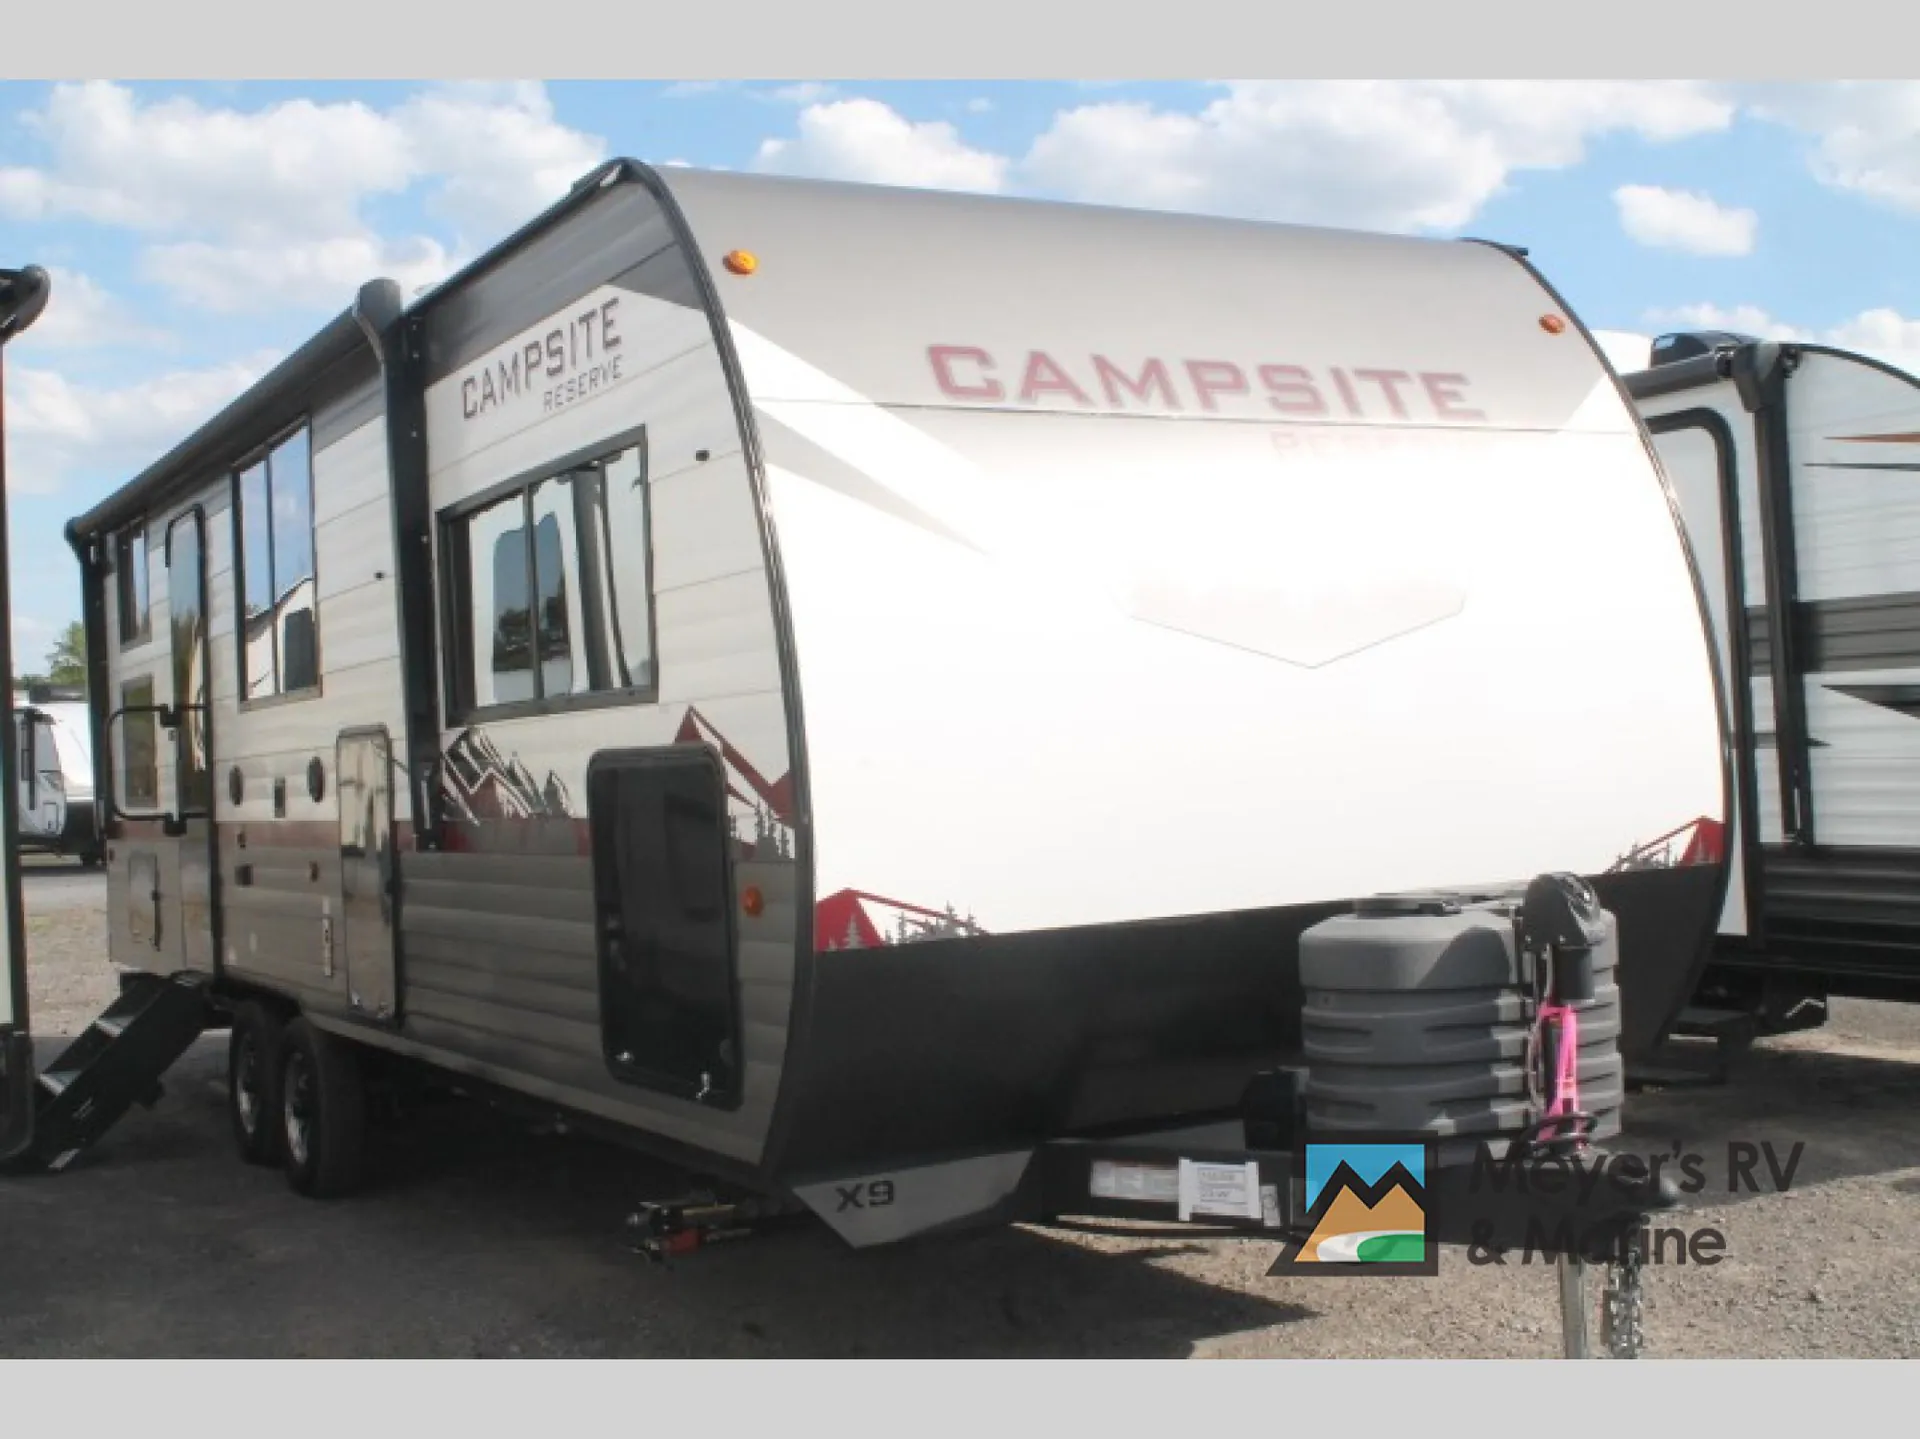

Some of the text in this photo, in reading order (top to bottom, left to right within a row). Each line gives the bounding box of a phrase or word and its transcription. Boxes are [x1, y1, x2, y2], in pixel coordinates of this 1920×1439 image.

[462, 297, 622, 421] CAMPSITE
[544, 354, 623, 412] RESERVE
[927, 344, 1488, 422] CAMPSITE
[836, 1180, 894, 1212] X9
